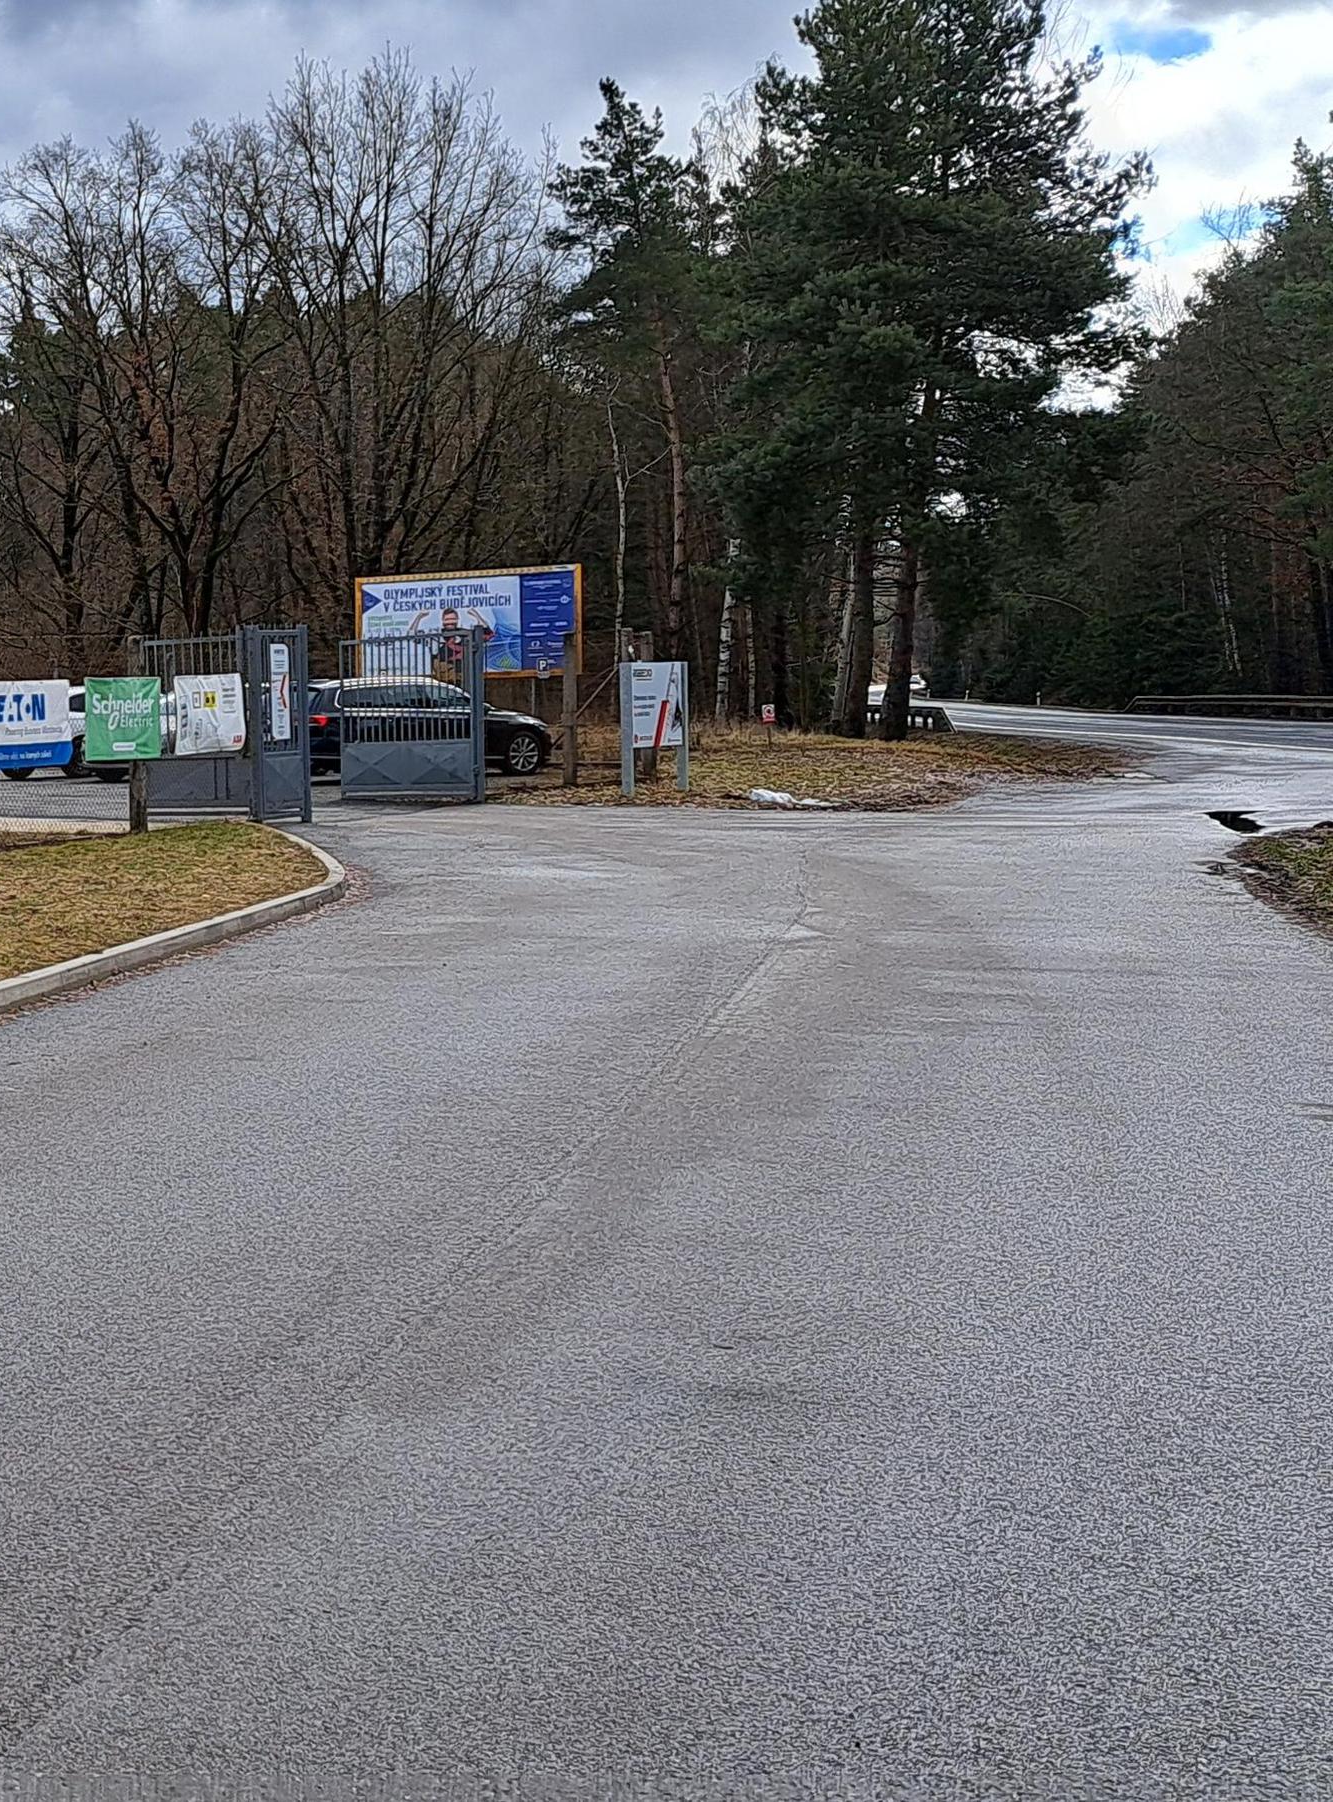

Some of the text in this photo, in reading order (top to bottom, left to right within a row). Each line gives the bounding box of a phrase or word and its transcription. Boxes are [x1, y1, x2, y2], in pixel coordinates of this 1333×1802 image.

[383, 583, 491, 600] OLYMPIJSKÝ FESTIVAL
[383, 594, 511, 612] V ČESKÝCH BUDĚJOVICÍCH
[92, 693, 154, 715] Schneider
[119, 715, 154, 728] Electric
